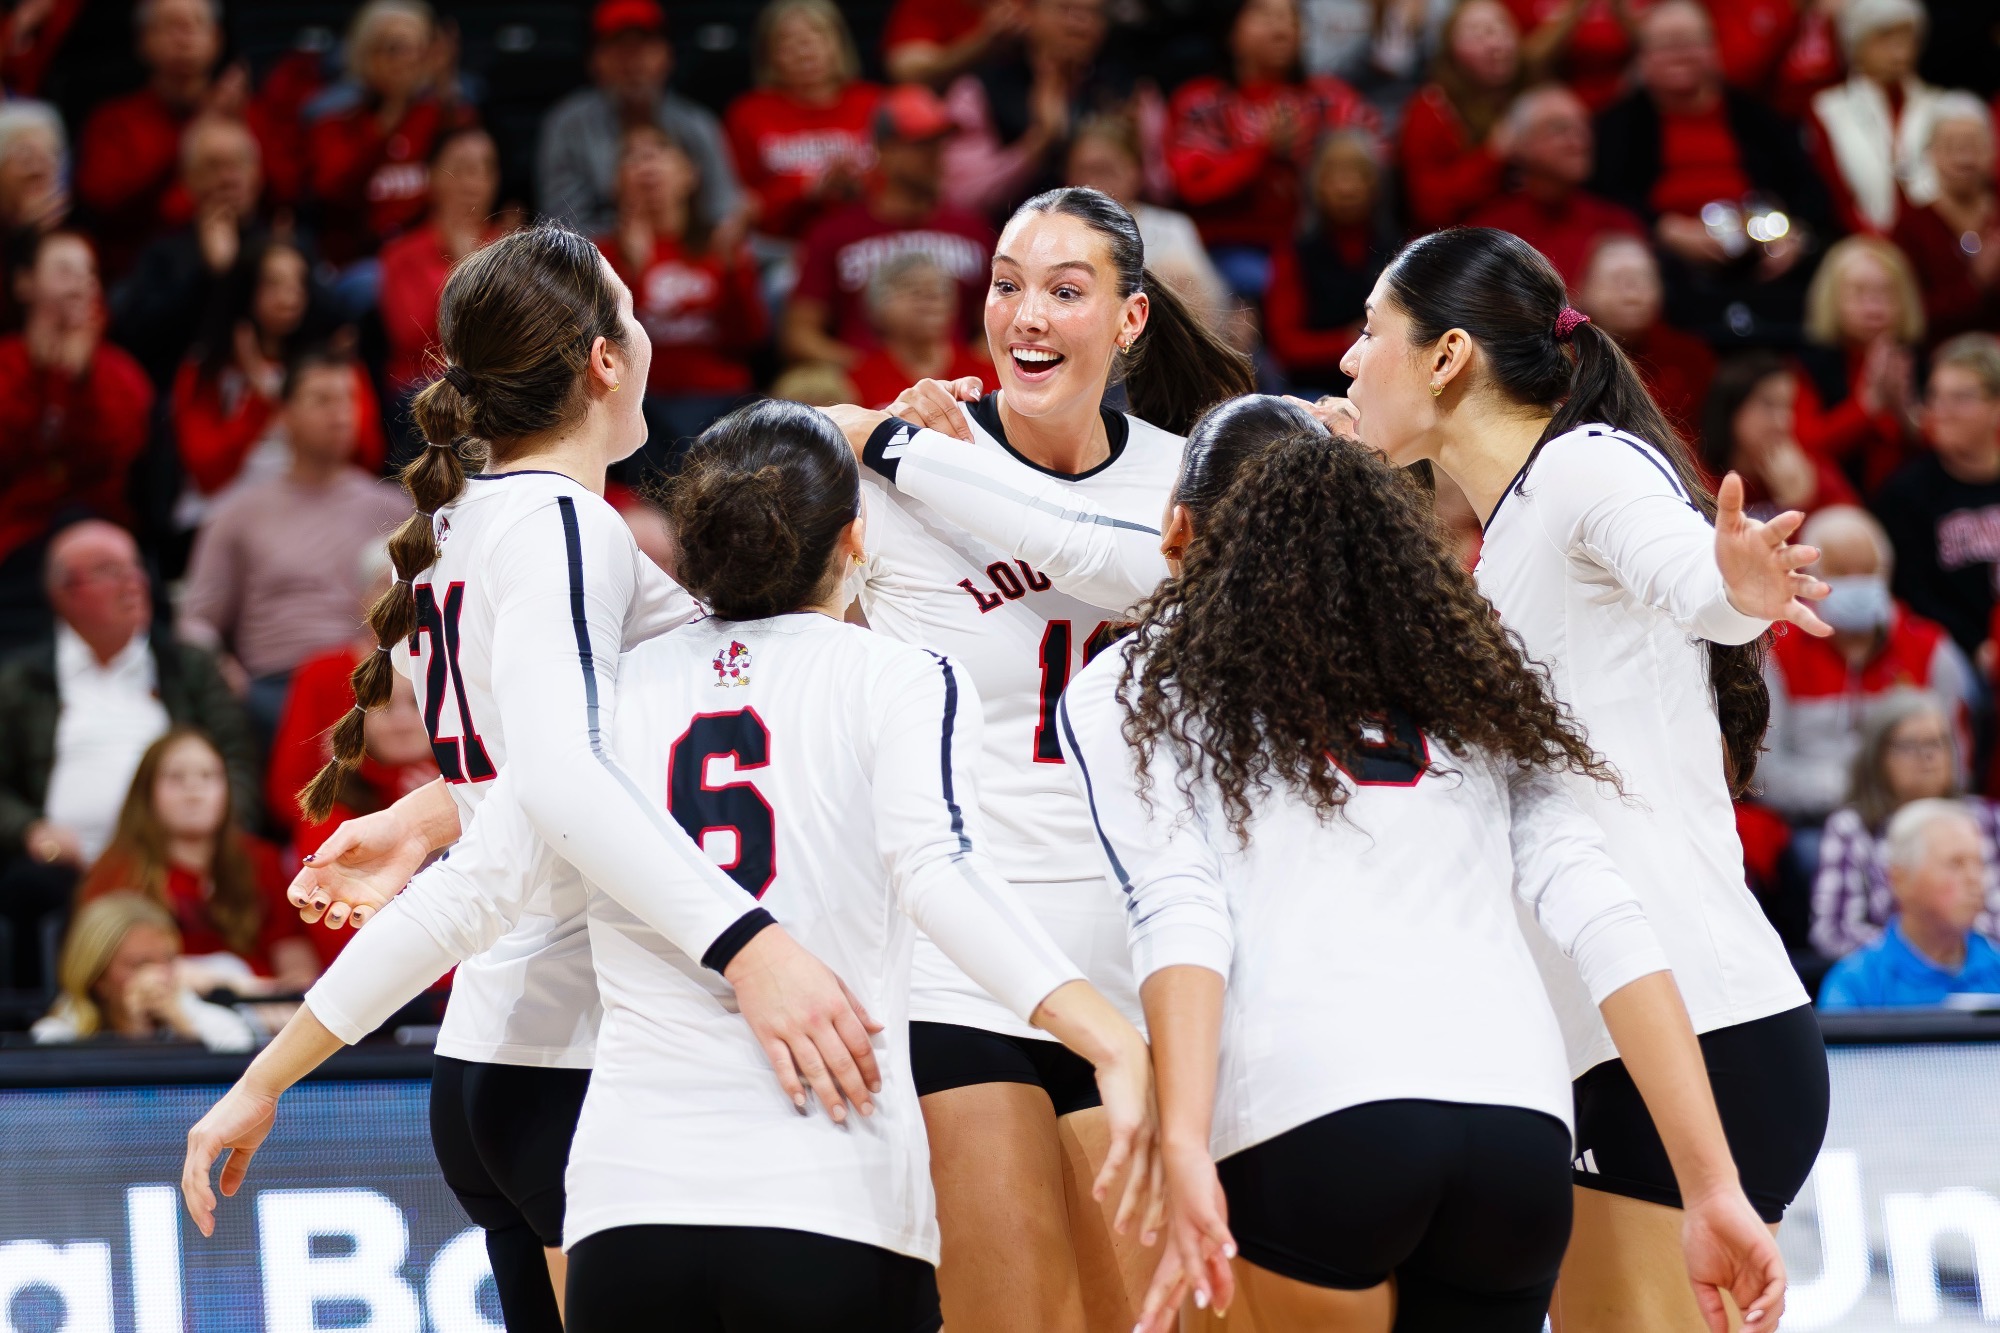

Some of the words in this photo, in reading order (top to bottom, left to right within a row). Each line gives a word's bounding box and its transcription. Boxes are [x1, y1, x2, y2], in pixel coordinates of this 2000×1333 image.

[408, 581, 498, 785] 21
[1033, 619, 1141, 764] 1
[667, 705, 777, 902] 6
